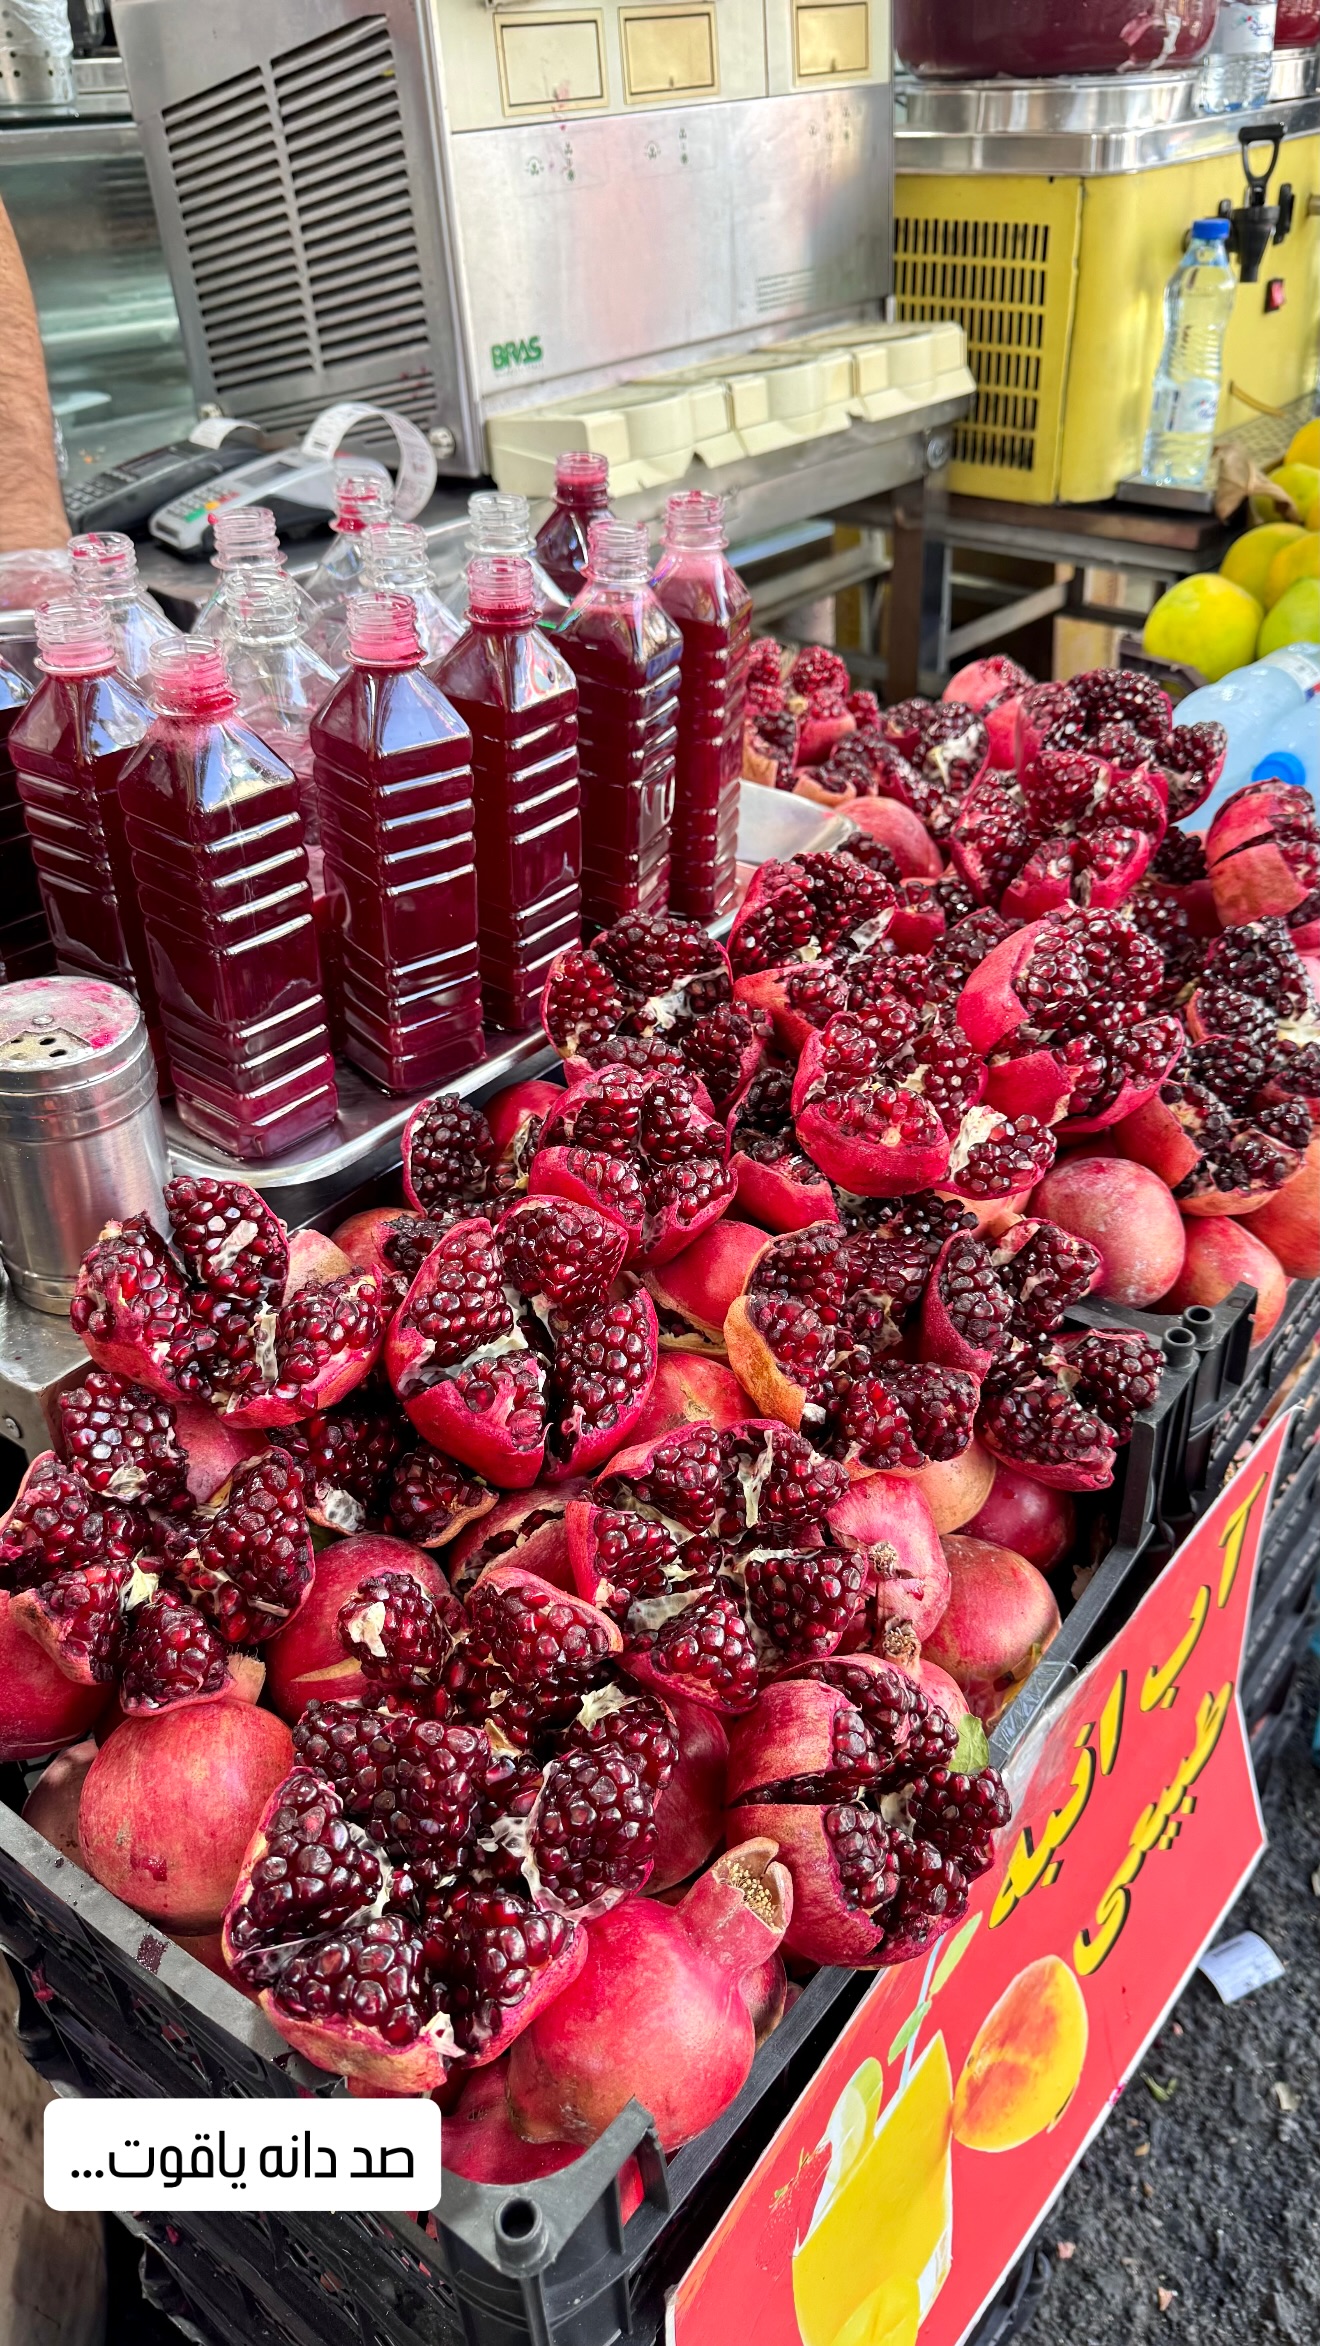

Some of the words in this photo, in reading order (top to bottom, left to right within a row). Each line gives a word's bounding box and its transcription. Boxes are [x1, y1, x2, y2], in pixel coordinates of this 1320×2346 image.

[491, 335, 543, 371] BRAS
[1141, 1472, 1269, 1712] آب
[988, 1669, 1127, 1929] انبه
[1073, 1681, 1233, 1976] طبیعی
